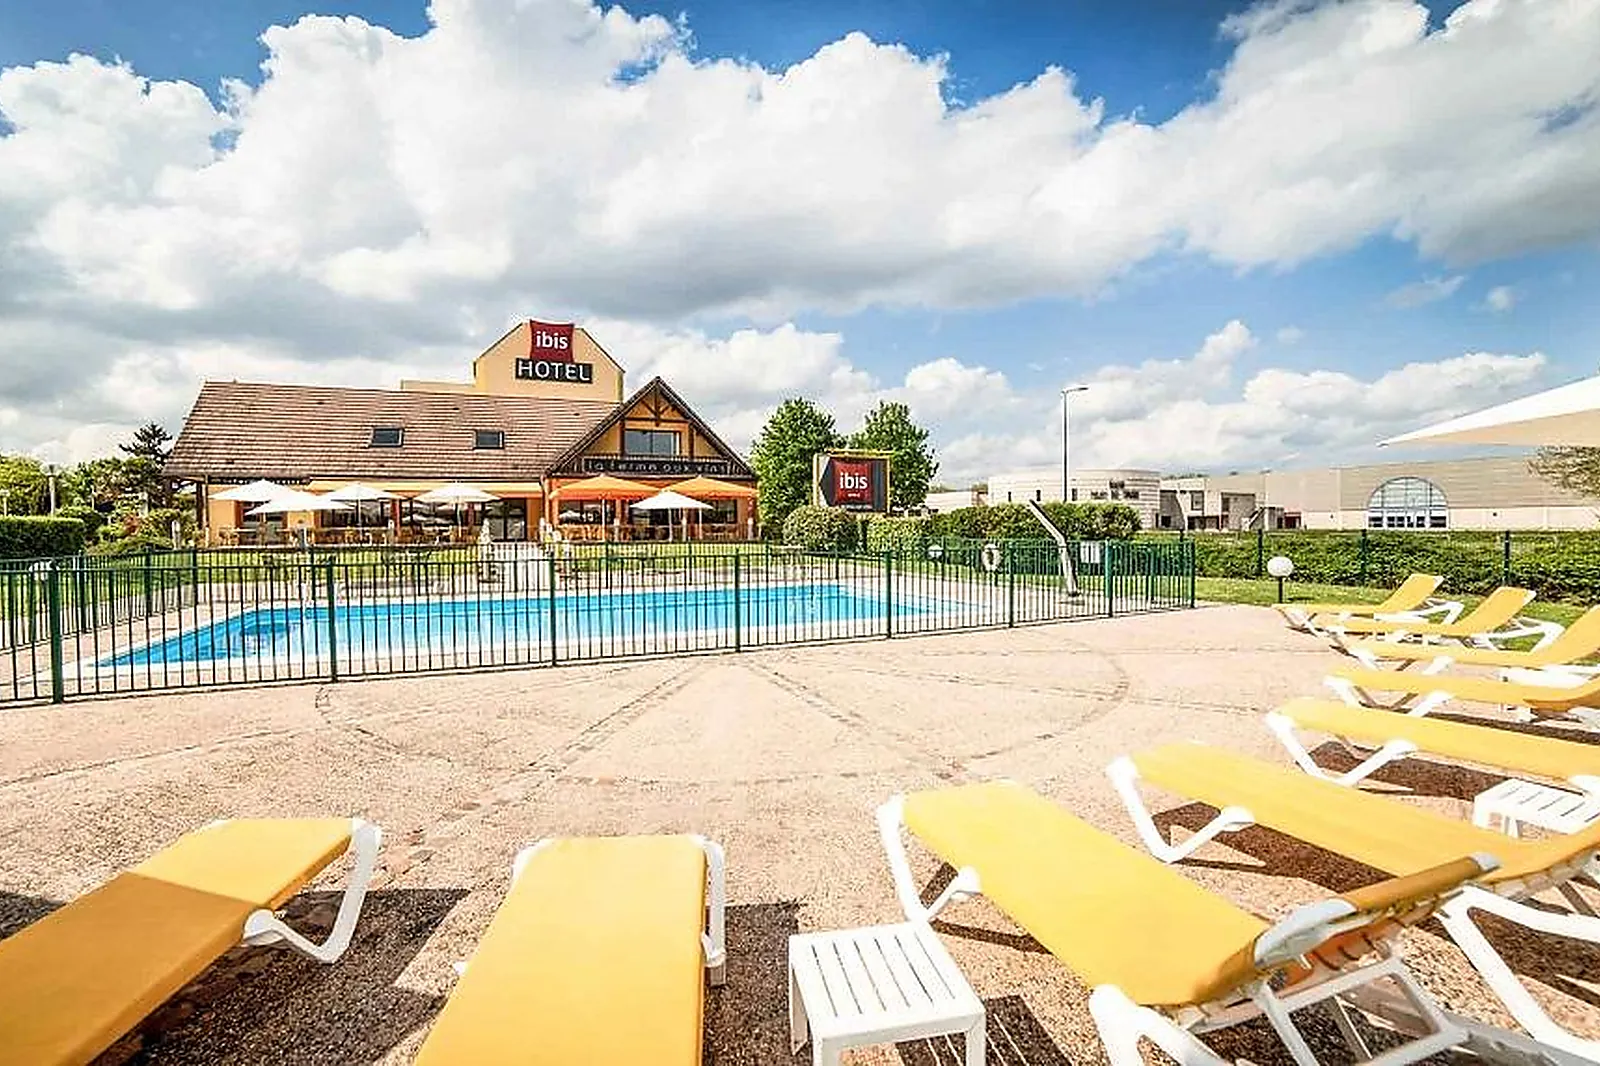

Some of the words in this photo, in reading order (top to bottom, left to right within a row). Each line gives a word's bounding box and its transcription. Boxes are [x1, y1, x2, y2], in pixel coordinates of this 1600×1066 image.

[535, 331, 569, 349] ibis
[518, 360, 590, 381] HOTEL
[839, 472, 868, 489] ibis
